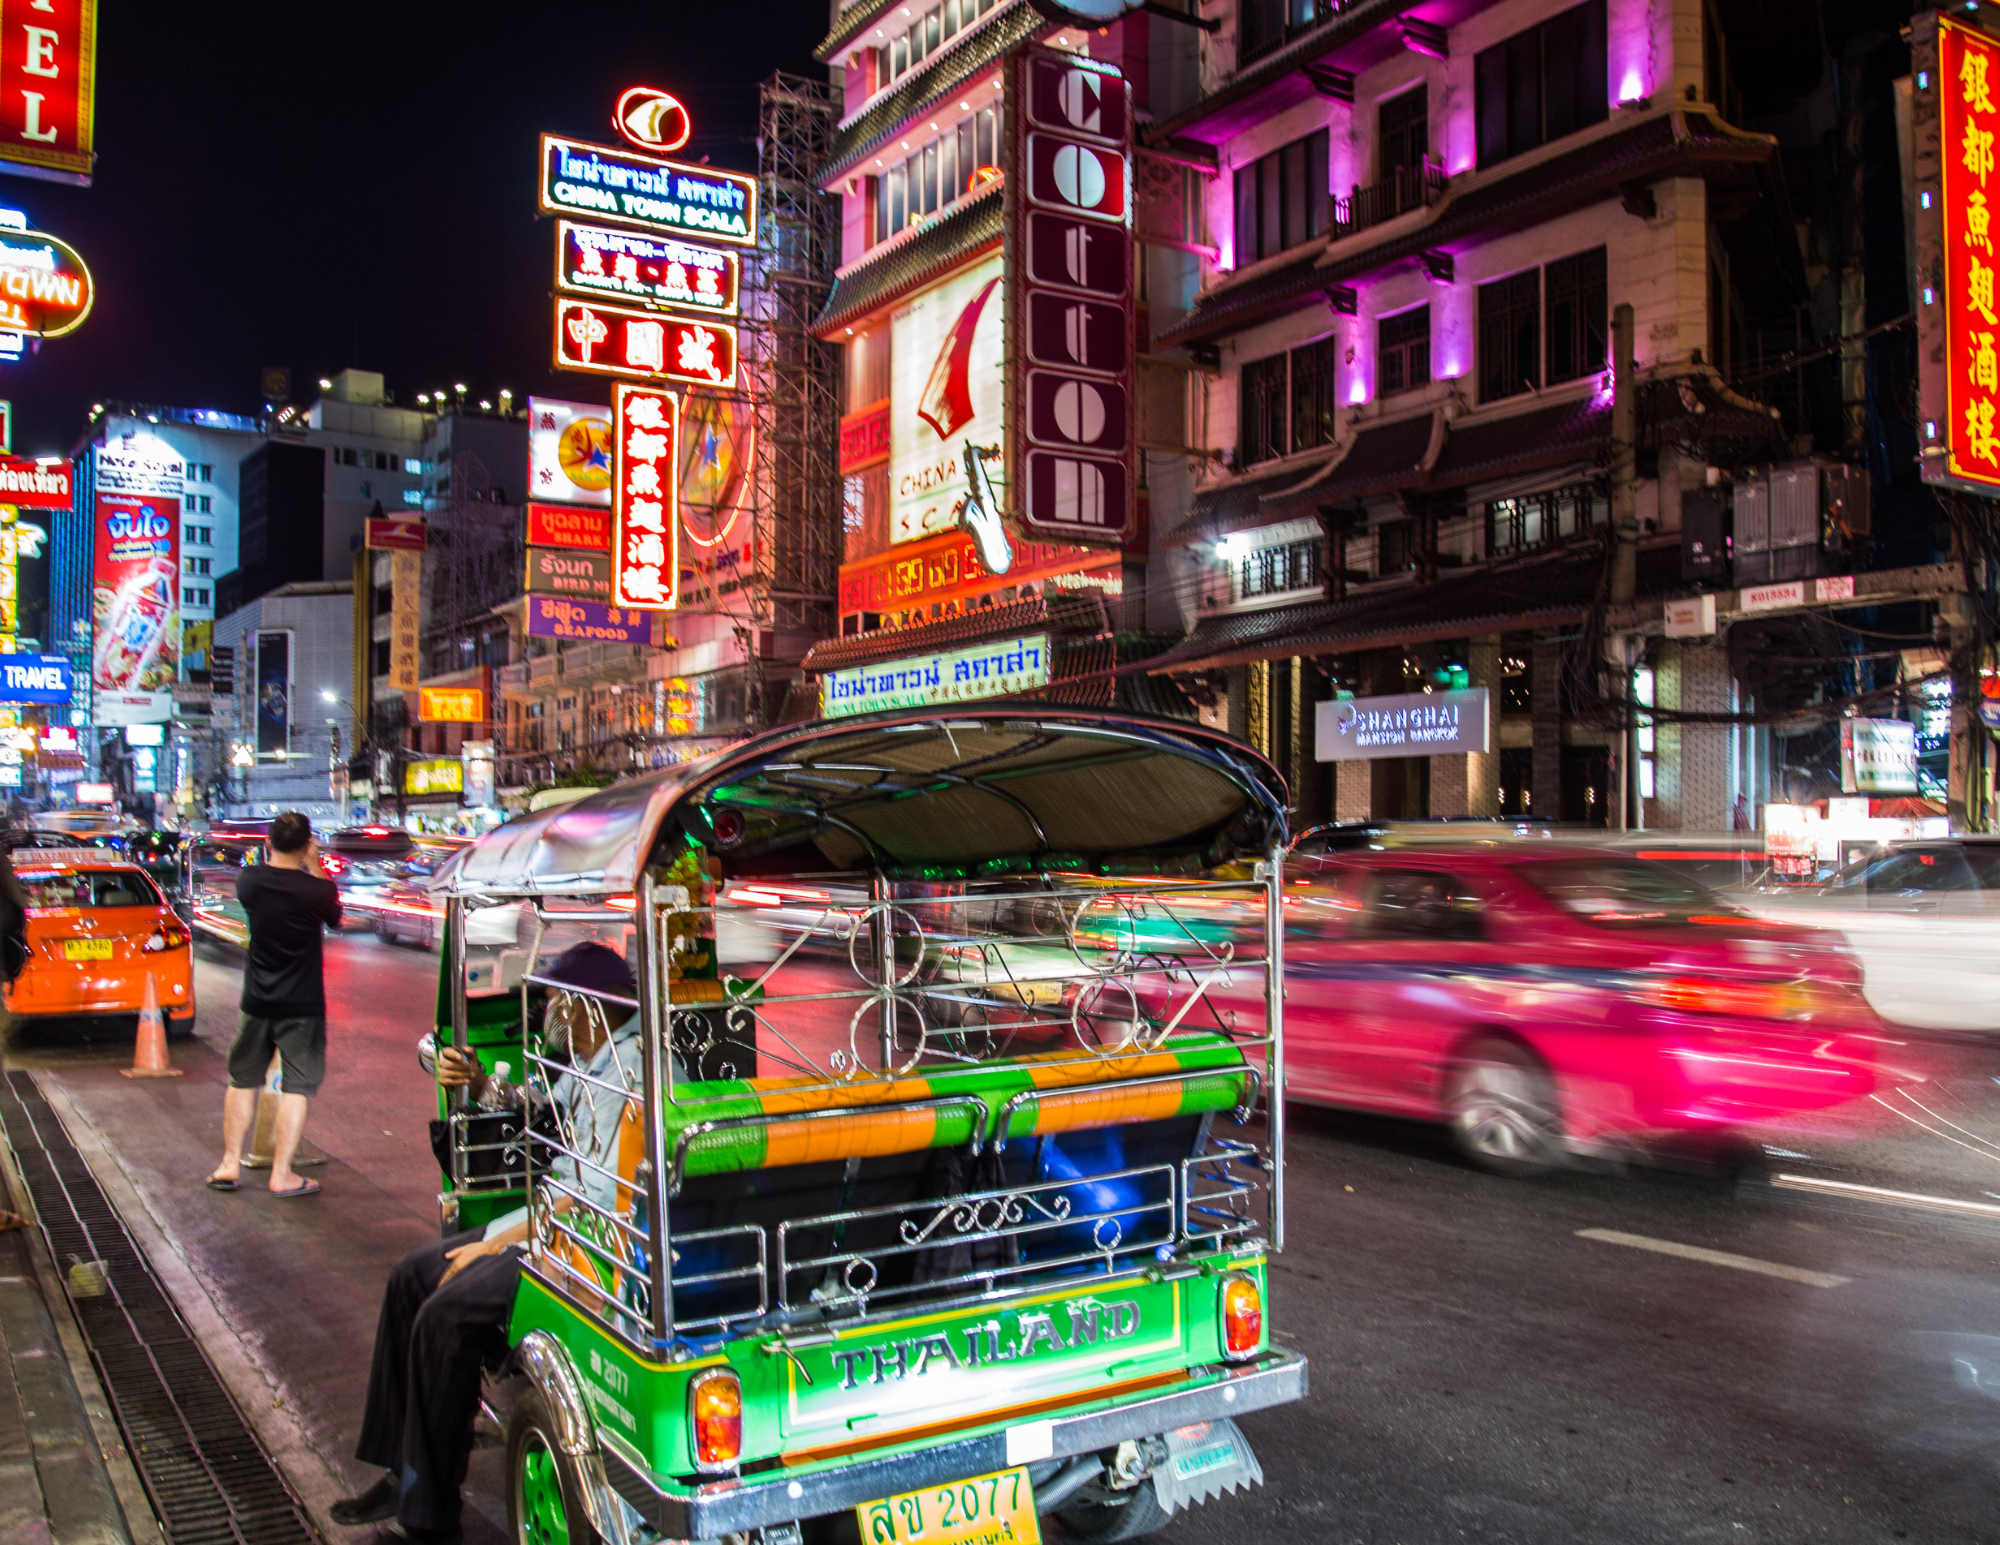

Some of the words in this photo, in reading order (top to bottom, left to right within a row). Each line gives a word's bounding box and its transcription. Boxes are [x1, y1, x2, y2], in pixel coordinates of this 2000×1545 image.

[20, 0, 60, 143] EL
[553, 181, 619, 212] CHINA
[620, 193, 682, 223] TOWN
[683, 205, 747, 235] SCALA
[1958, 48, 2000, 468] 銀都魚翅酒樓
[900, 459, 957, 496] CHINA
[541, 511, 602, 534] หูฉลาม
[553, 531, 603, 547] SHARK
[540, 553, 594, 577] รังนก
[552, 576, 590, 591] BIRD
[553, 622, 628, 641] SEAFOOD
[4, 665, 67, 690] TRAVEL
[889, 692, 926, 709] SCALA
[1356, 704, 1460, 732] SHANGHAI
[1356, 729, 1406, 747] MANSION
[1409, 725, 1459, 743] BANGKOK
[830, 1298, 1142, 1391] THAILAND
[603, 1357, 629, 1399] 2077
[937, 1472, 1021, 1529] 2077
